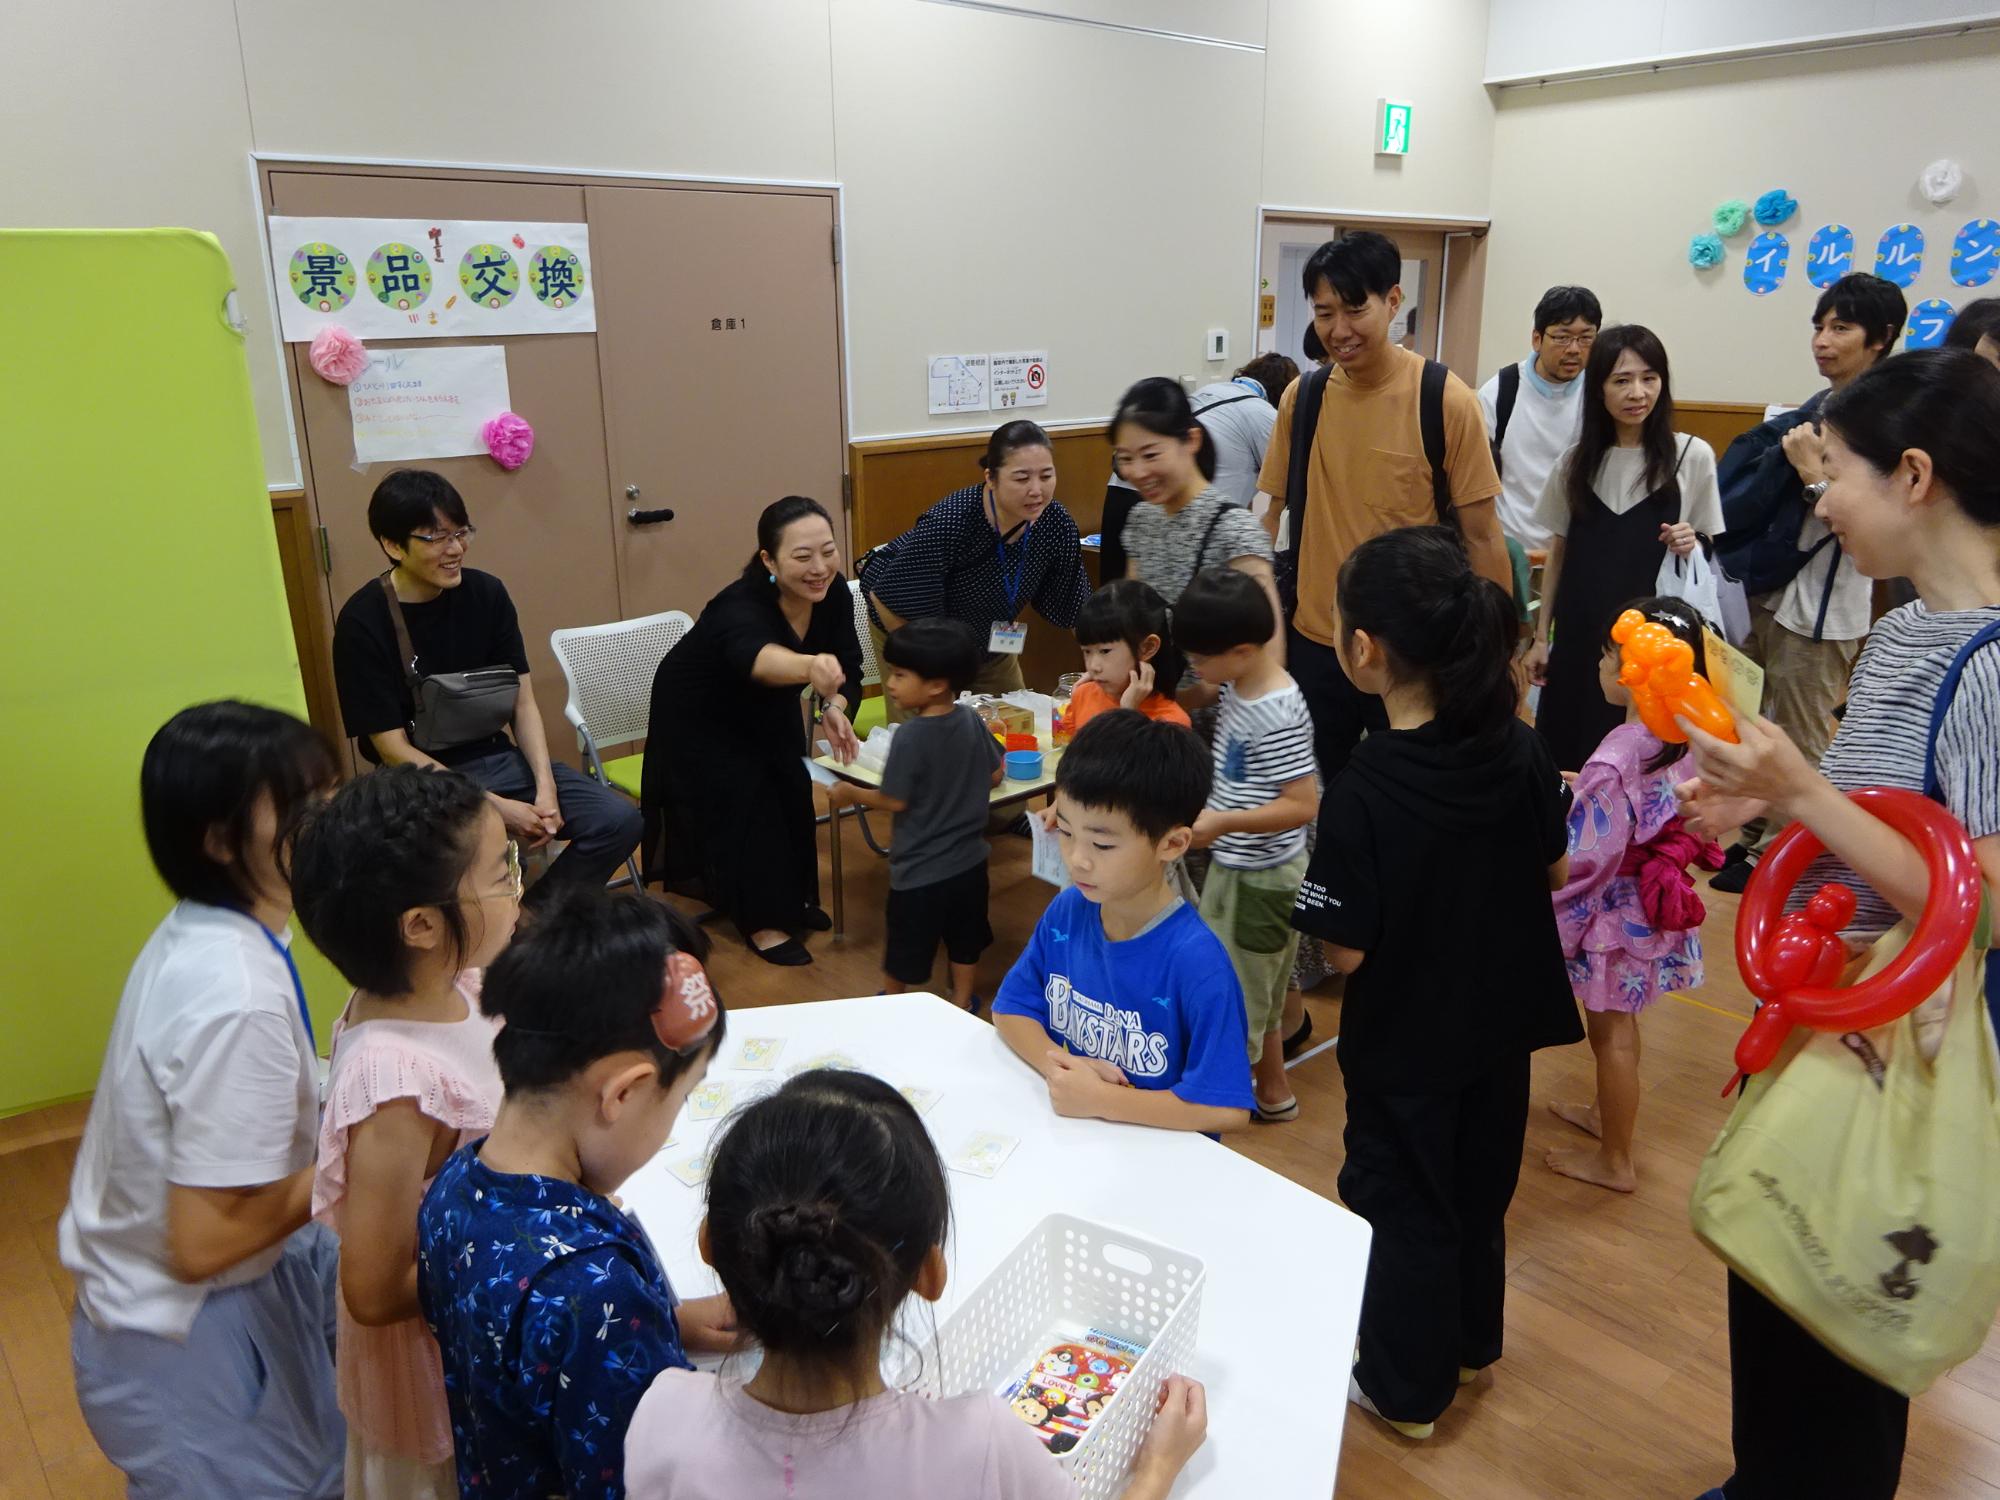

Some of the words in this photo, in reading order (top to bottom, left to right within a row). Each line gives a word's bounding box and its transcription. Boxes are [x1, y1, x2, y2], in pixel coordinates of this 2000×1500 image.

[302, 254, 577, 298] 景品交換
[1313, 883, 1326, 892] TOO
[1310, 891, 1328, 901] WHAT
[1328, 897, 1341, 907] YOU
[1103, 1002, 1142, 1031] DeNA
[1042, 1376, 1067, 1391] Love
[1068, 1383, 1078, 1394] It
